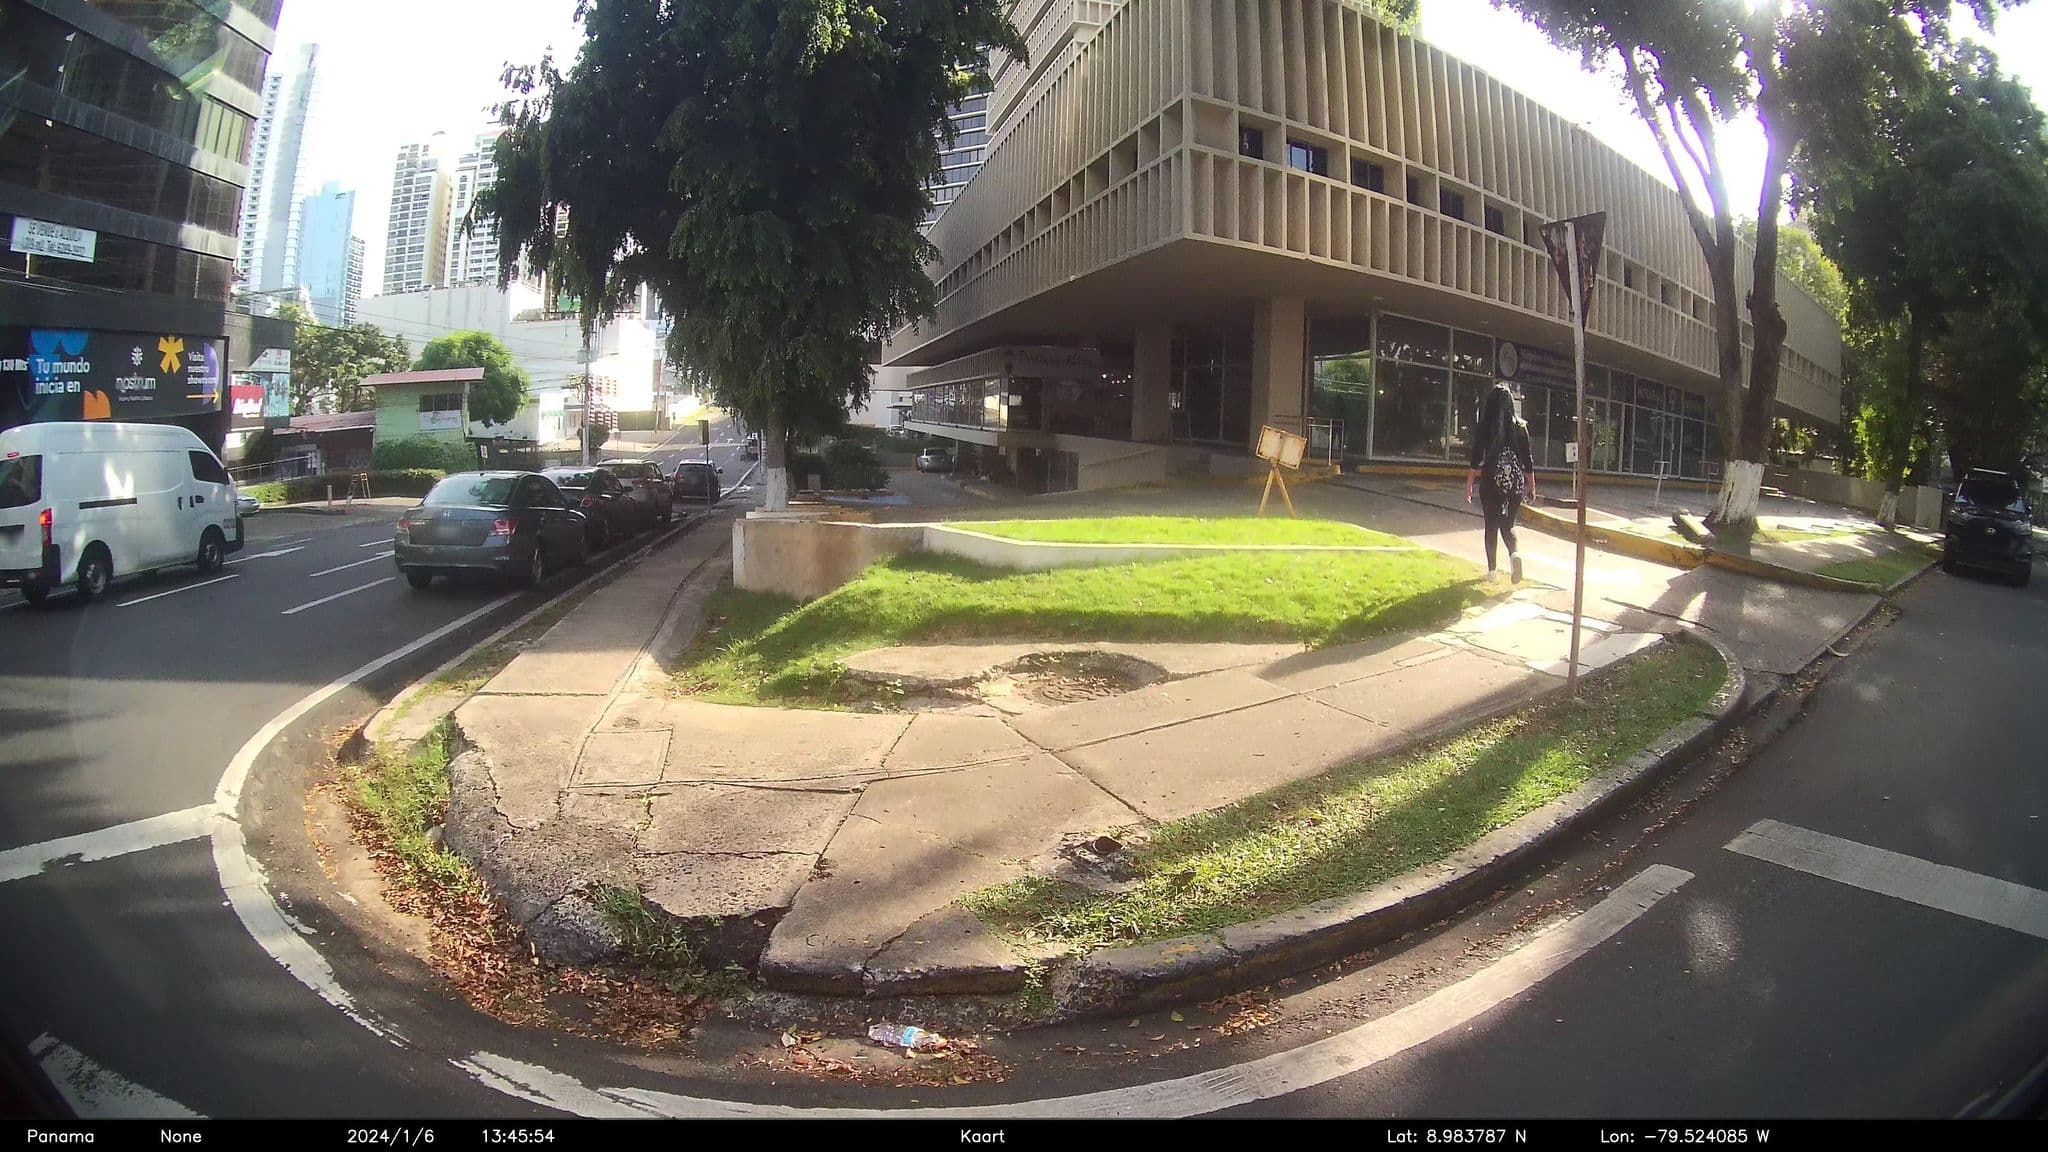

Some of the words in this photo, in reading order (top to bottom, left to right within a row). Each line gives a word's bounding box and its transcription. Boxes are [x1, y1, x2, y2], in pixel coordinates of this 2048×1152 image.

[188, 351, 204, 362] Visita
[36, 358, 50, 374] Tu
[53, 356, 90, 374] mundo
[187, 365, 209, 373] nuestro
[187, 374, 216, 385] showroom
[36, 376, 64, 395] inicia
[67, 380, 80, 393] en
